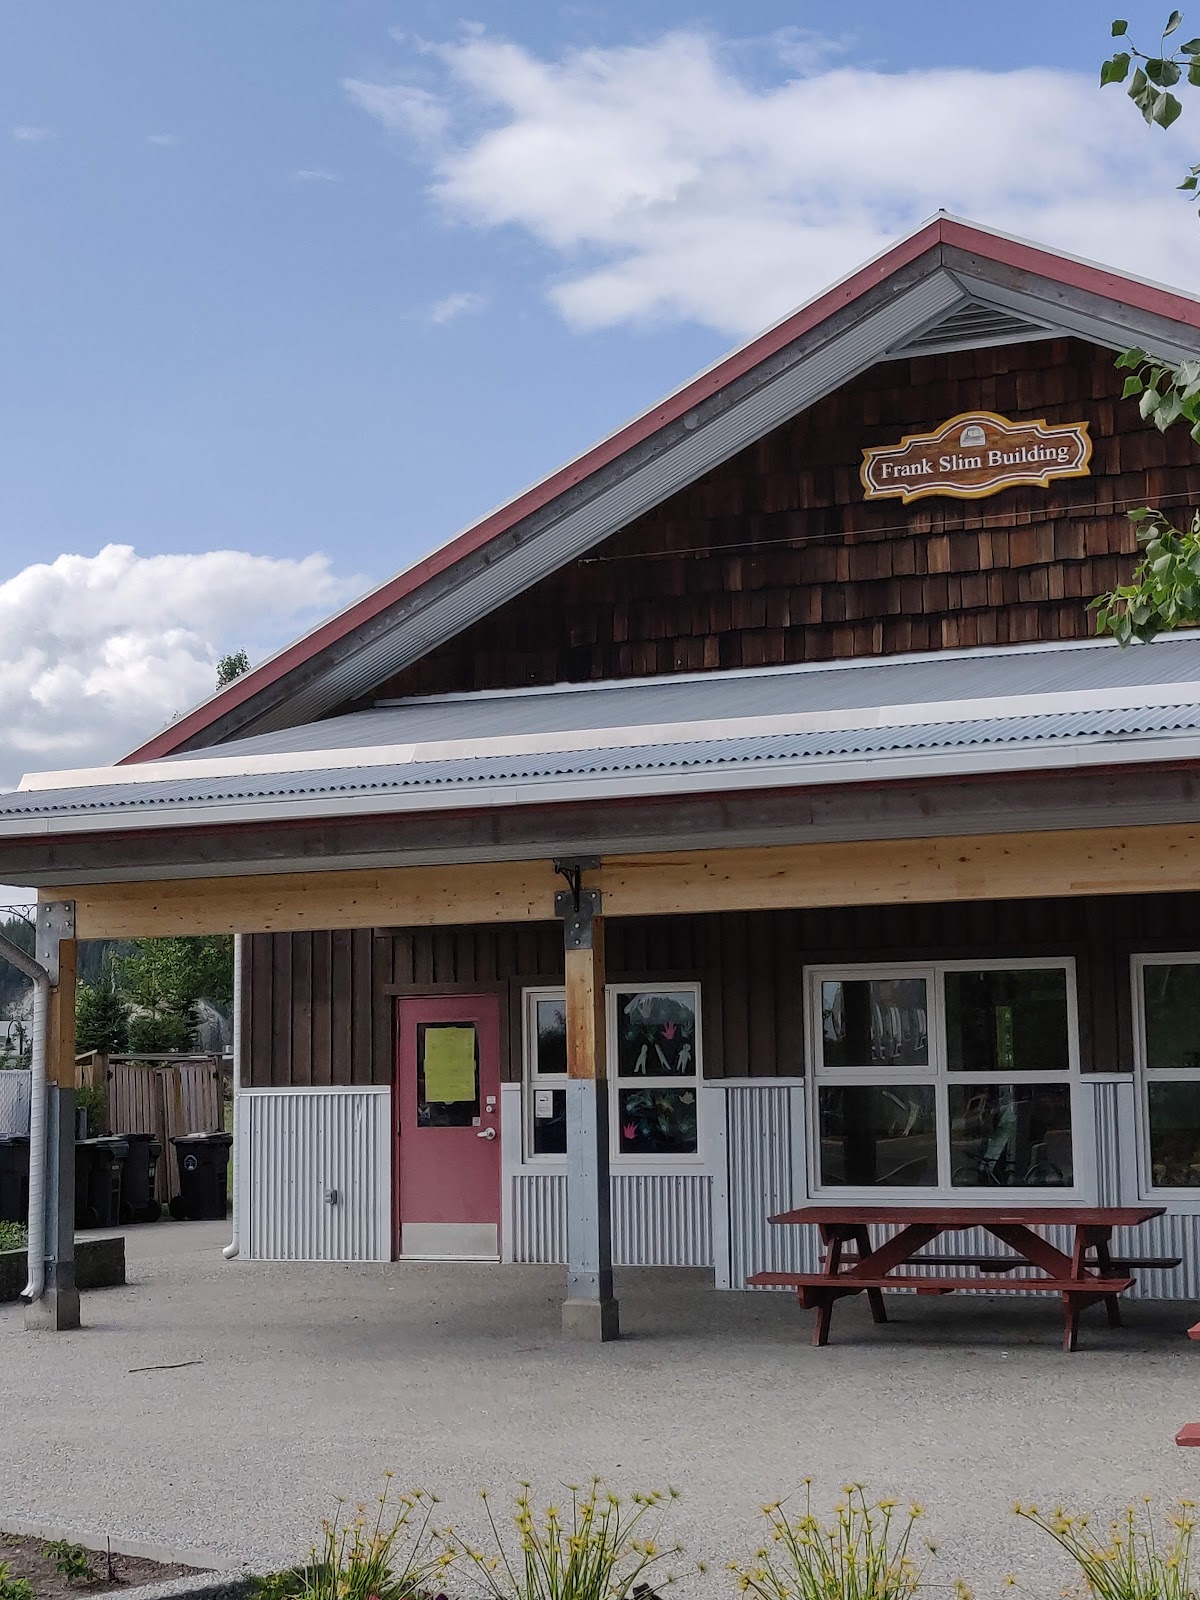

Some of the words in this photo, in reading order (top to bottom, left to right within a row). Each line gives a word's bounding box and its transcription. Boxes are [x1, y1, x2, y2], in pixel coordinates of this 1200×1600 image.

[881, 458, 934, 479] Frank
[939, 454, 982, 472] Slim
[988, 443, 1070, 467] Building
